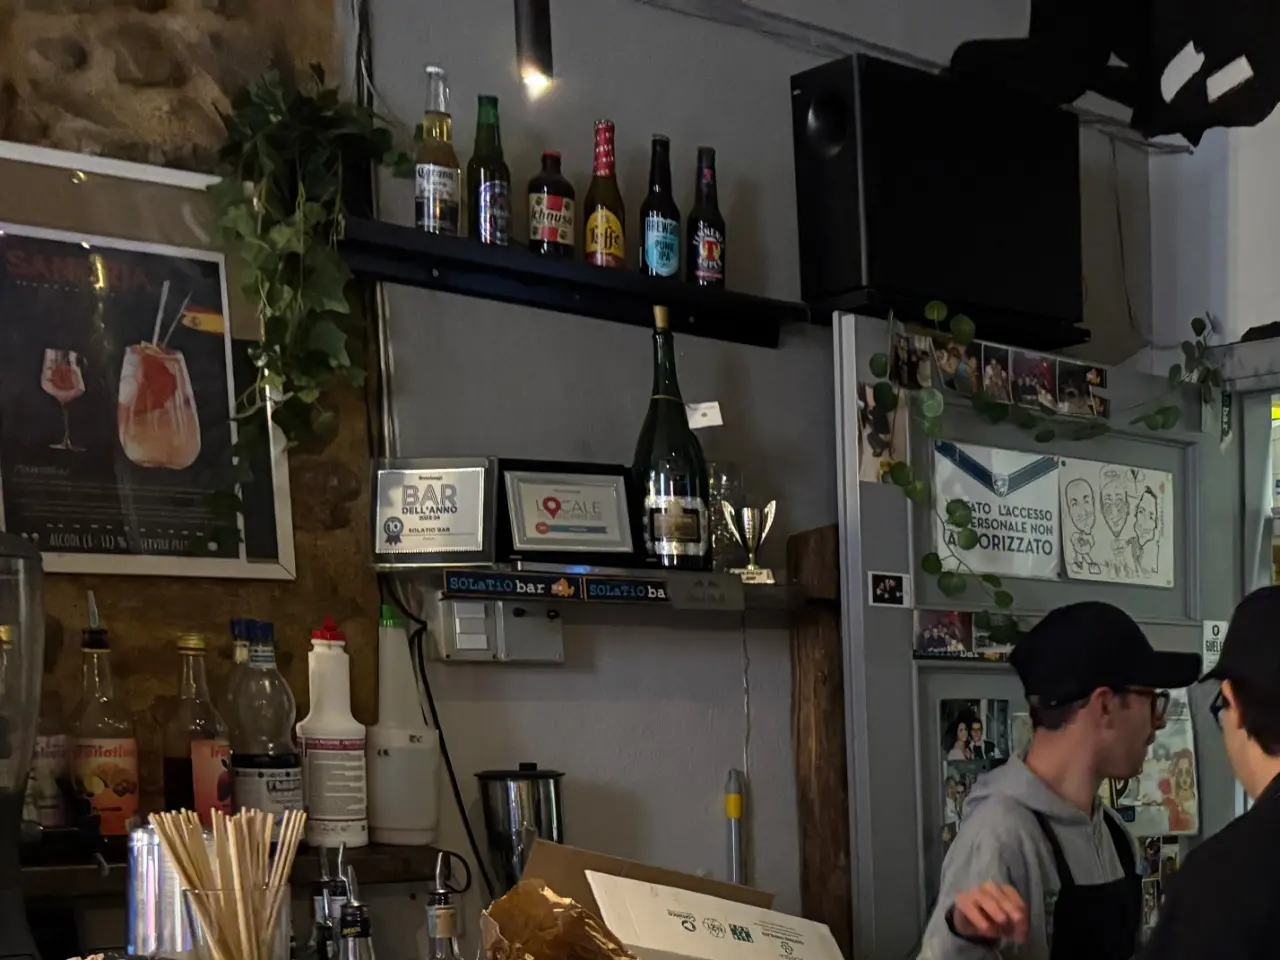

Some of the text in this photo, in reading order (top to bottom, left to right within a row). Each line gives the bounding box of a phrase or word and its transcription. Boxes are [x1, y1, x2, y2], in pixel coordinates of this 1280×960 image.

[402, 483, 457, 506] BAR
[402, 505, 458, 515] DELL'ANNO
[998, 503, 1053, 521] L'ACCESSO
[385, 521, 401, 533] 10
[970, 517, 1054, 536] ERSONALE NON
[947, 531, 1054, 556] AORIZZATO
[515, 580, 545, 595] bar
[647, 585, 667, 599] ba
